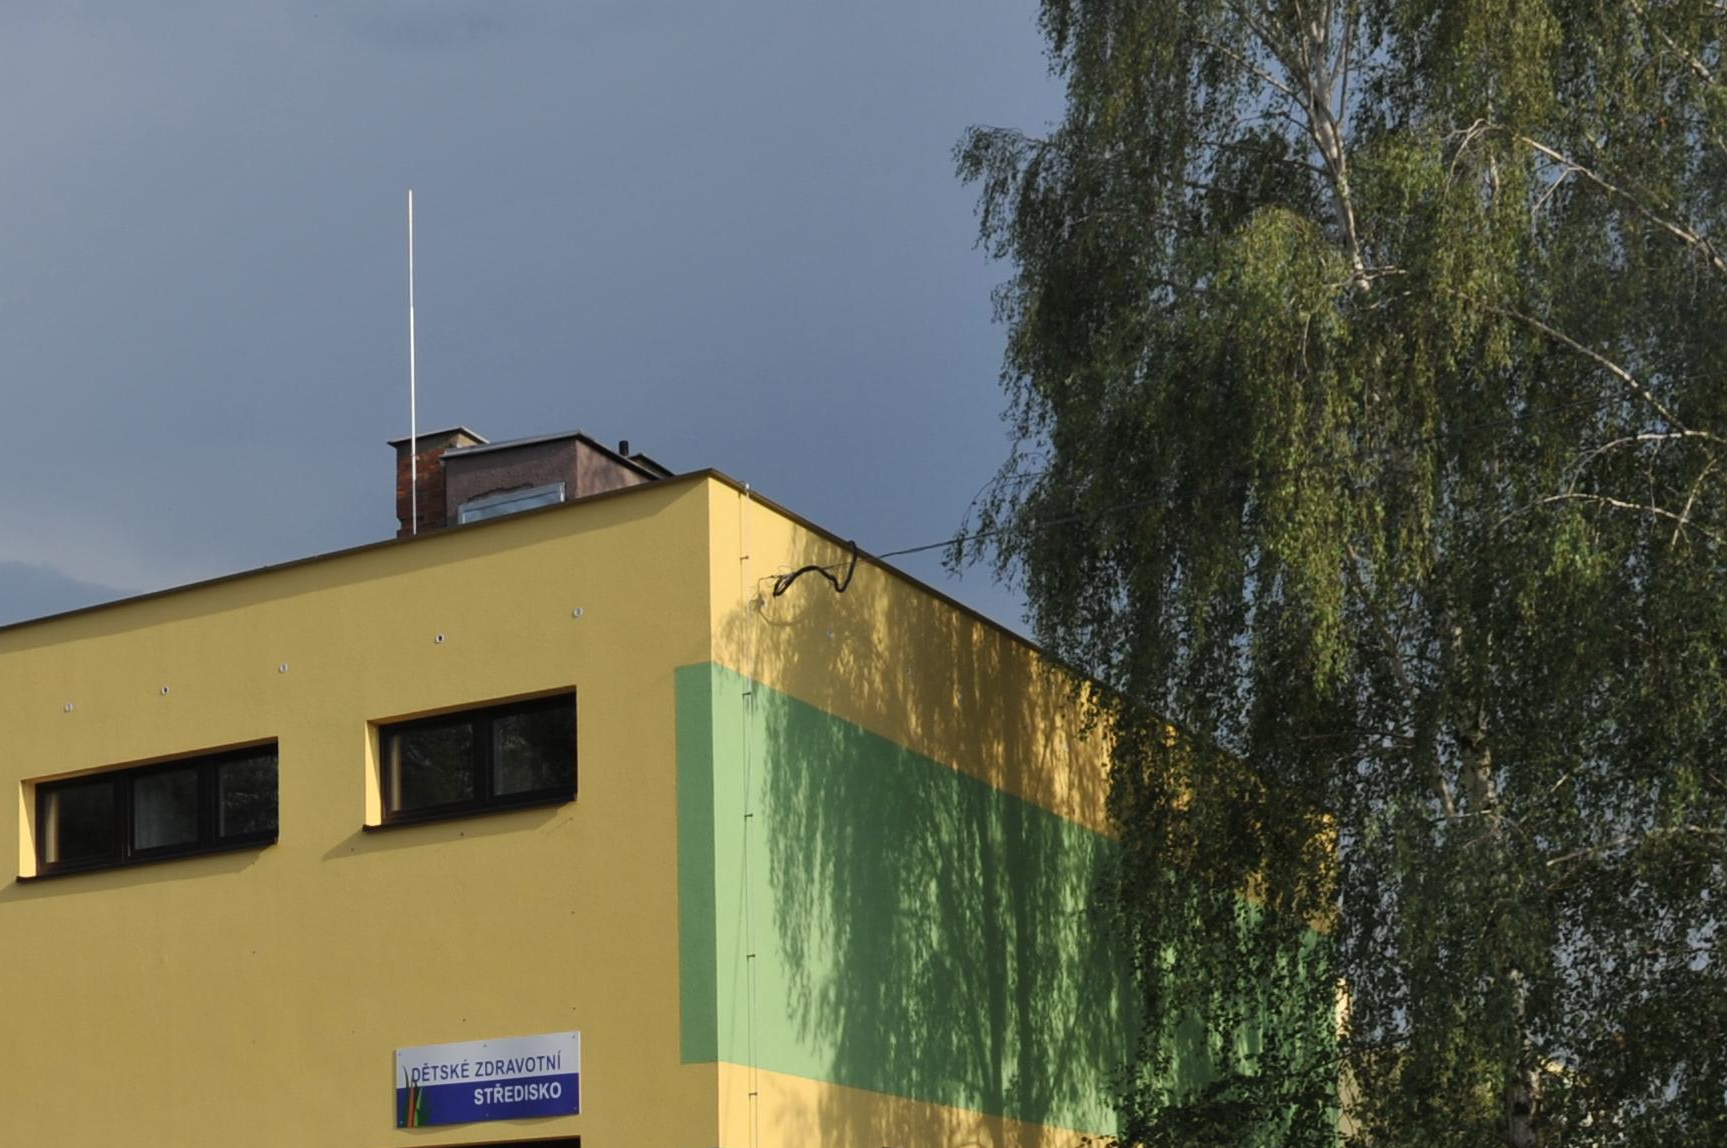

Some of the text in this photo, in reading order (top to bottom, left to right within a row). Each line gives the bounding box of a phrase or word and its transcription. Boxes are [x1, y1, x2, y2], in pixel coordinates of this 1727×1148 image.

[411, 1050, 562, 1083] DĚTSKÉ ZDRAVOTNÍ
[473, 1081, 562, 1106] STŘEDISKO
